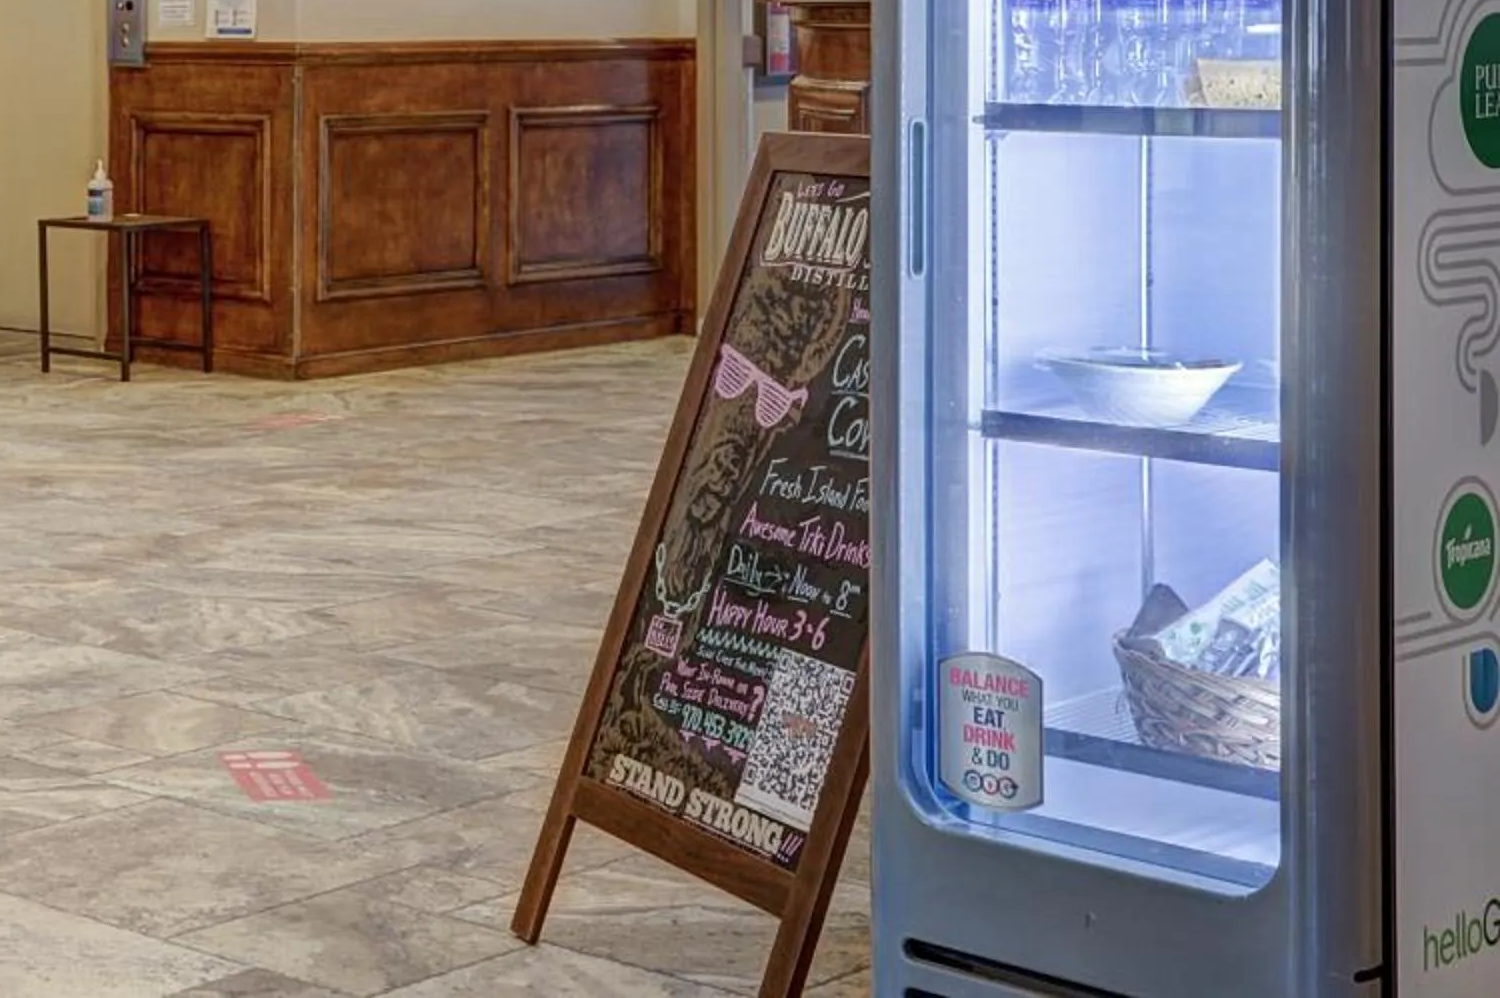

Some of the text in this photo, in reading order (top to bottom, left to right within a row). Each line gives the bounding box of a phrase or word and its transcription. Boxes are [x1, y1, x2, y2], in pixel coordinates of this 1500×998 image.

[1475, 63, 1500, 91] PU
[764, 191, 869, 269] BUFFALO
[760, 458, 803, 500] Fresh
[802, 465, 851, 510] Island
[739, 501, 797, 548] Awesome
[825, 521, 872, 569] Drinks
[950, 667, 1030, 698] BALANCE
[962, 688, 1019, 712] WHAT YOU
[987, 749, 1011, 771] DO
[609, 754, 685, 808] STAND
